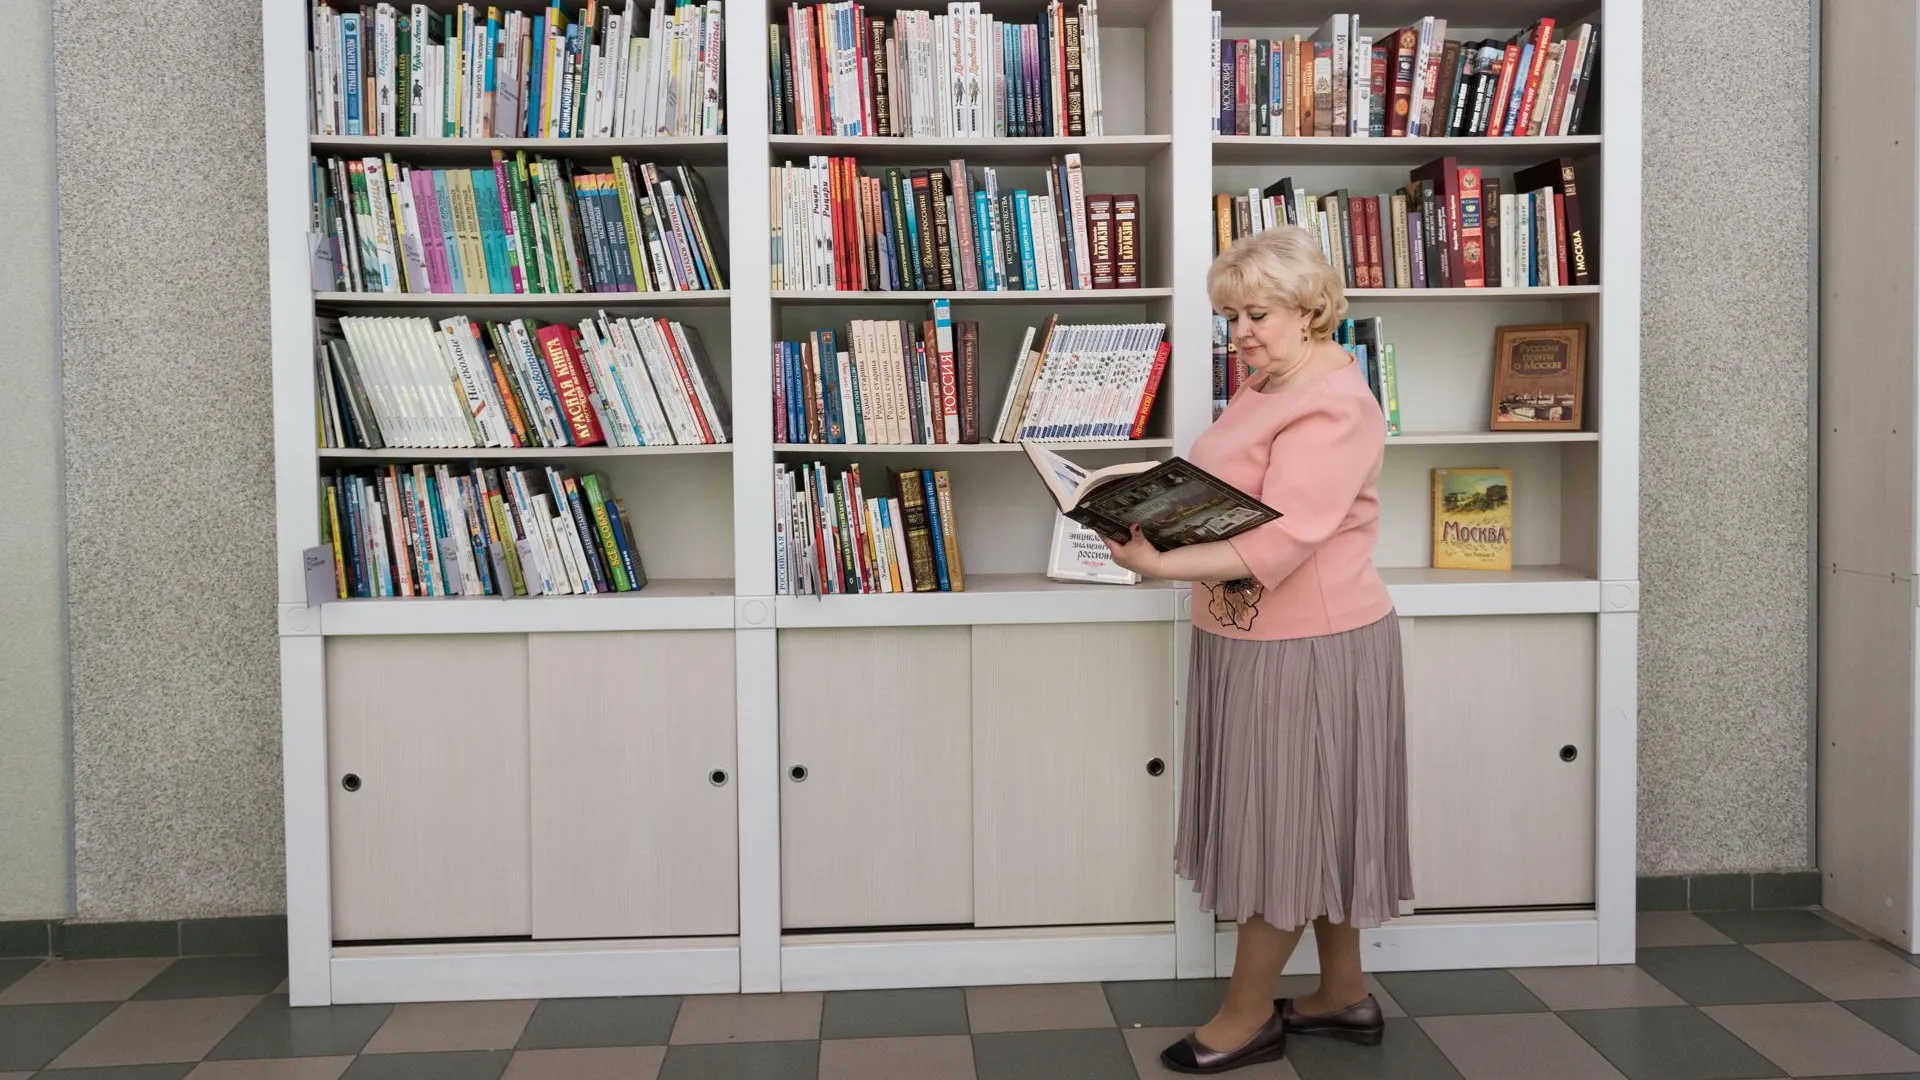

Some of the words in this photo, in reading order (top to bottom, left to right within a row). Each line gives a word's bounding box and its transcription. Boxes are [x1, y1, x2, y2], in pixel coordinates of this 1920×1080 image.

[412, 20, 422, 43] света
[953, 18, 962, 36] мир
[968, 18, 977, 35] мир
[1540, 26, 1551, 48] МОСКВА
[347, 39, 355, 64] НАРОДЫ
[412, 45, 422, 71] Чудеса
[710, 20, 720, 82] животные
[953, 38, 963, 76] Древний
[968, 38, 978, 76] Древний
[1534, 49, 1545, 76] ВОЕННАЯ
[348, 71, 357, 94] СТРАНЫ
[785, 69, 793, 103] АНТИЧНЫЙ
[1222, 62, 1231, 111] МОСКОВИЯ
[1526, 87, 1535, 103] ДЕНЬ
[561, 75, 571, 133] ЭНЦИКЛОПЕДИЯ
[811, 185, 819, 214] Рыцари
[822, 181, 830, 217] Рыцари
[1073, 174, 1081, 200] РОССИИ
[371, 179, 388, 245] Растения
[595, 207, 606, 239] НАСЕКОМЫЕ
[669, 203, 685, 244] ЖИВОТНЫХ
[919, 194, 929, 230] РОССИЯНЕ
[1002, 196, 1010, 233] ОТЕЧЕСТВА
[1075, 202, 1083, 232] ИСТОРИЯ
[607, 221, 617, 243] ПТИЦЫ
[616, 221, 626, 243] ПТИЦЫ
[1097, 221, 1108, 259] КАРАМЗИН
[1122, 221, 1134, 259] КАРАМЗИН
[654, 252, 663, 275] ЗВЕРИ
[682, 247, 693, 276] ЗАГАДКИ
[1005, 234, 1013, 264] ИСТОРИЯ
[1574, 230, 1586, 270] МОСКВА
[451, 339, 480, 401] Насекомые
[519, 339, 550, 401] Животные
[547, 337, 566, 375] КНИГА
[859, 360, 869, 391] старина
[871, 360, 880, 390] старина
[882, 361, 891, 391] старина
[894, 360, 904, 392] старина
[941, 354, 957, 414] РОССИЯ
[560, 380, 591, 438] КРАСНАЯ
[863, 393, 872, 420] Родная
[875, 392, 884, 420] Родная
[886, 393, 895, 420] Родная
[898, 394, 907, 420] Родная
[572, 501, 595, 554] МЛЕКОПИТАЮЩИЕ
[595, 505, 611, 538] СОБАКЕ
[1442, 521, 1508, 545] МОСКВА
[778, 536, 787, 590] РОССИЙСКАЯ
